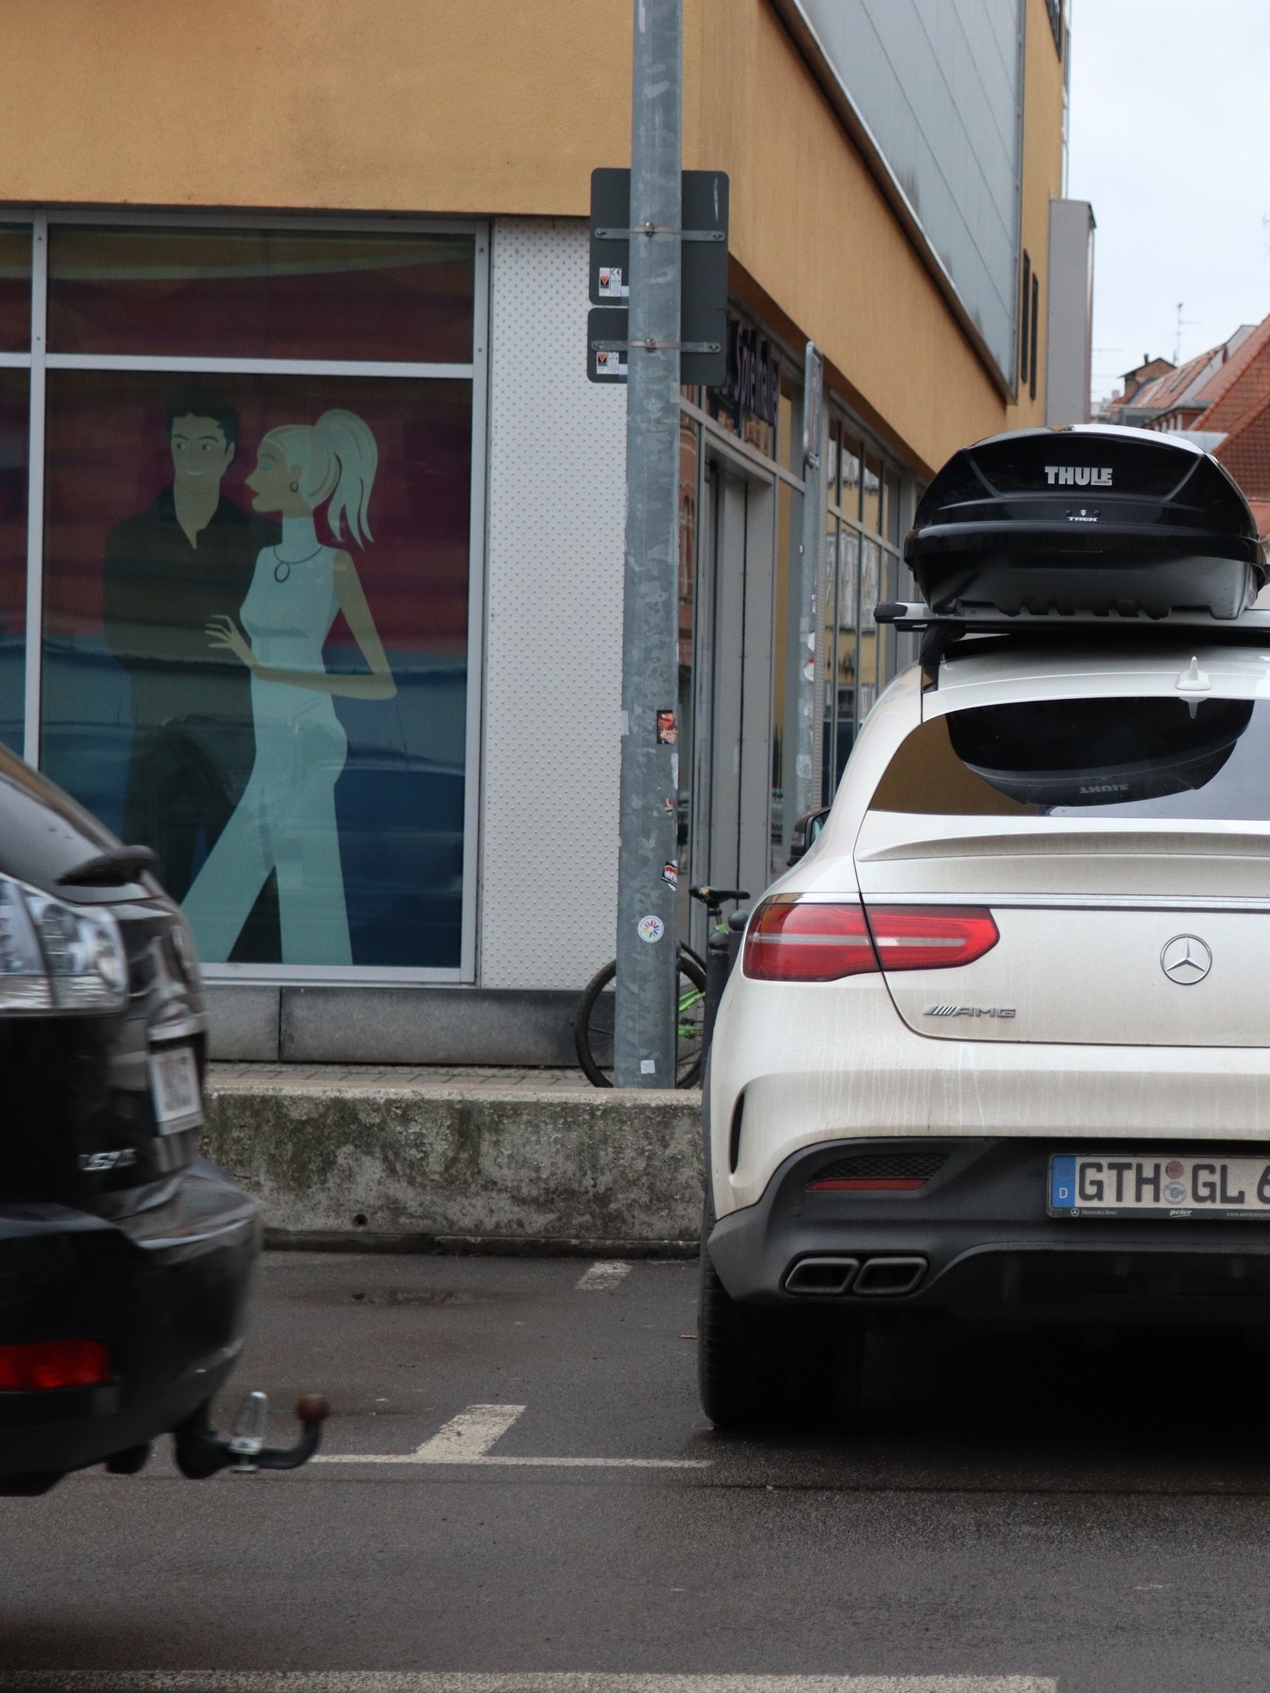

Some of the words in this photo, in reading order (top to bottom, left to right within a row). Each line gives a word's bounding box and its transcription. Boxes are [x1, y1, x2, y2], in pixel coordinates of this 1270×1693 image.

[1045, 466, 1113, 486] THULE
[952, 1006, 1016, 1018] AMG
[1078, 1162, 1161, 1202] GTH
[1191, 1163, 1245, 1204] GL
[1059, 1187, 1068, 1199] D
